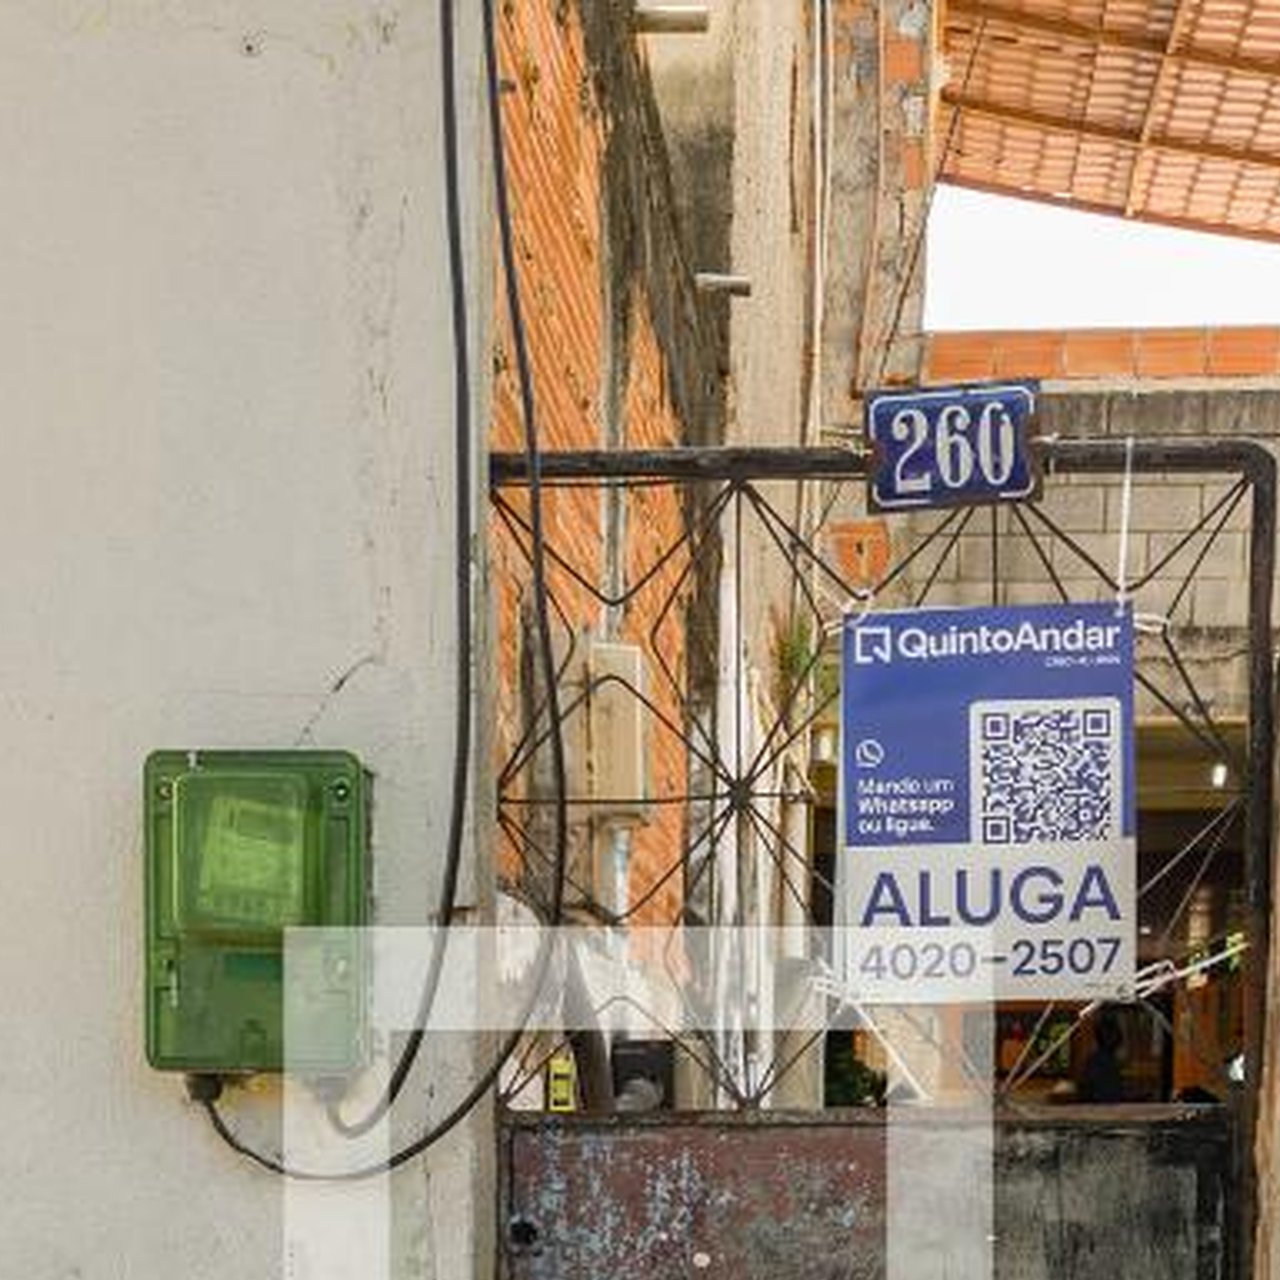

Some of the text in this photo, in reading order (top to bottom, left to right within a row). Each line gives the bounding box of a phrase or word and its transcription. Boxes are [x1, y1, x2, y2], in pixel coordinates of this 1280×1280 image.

[892, 403, 1014, 493] 260
[898, 620, 1121, 659] QuintoAndar
[923, 778, 955, 794] um
[858, 818, 882, 834] ou
[861, 864, 1122, 927] ALUGA
[860, 938, 1122, 980] 4020-2507
